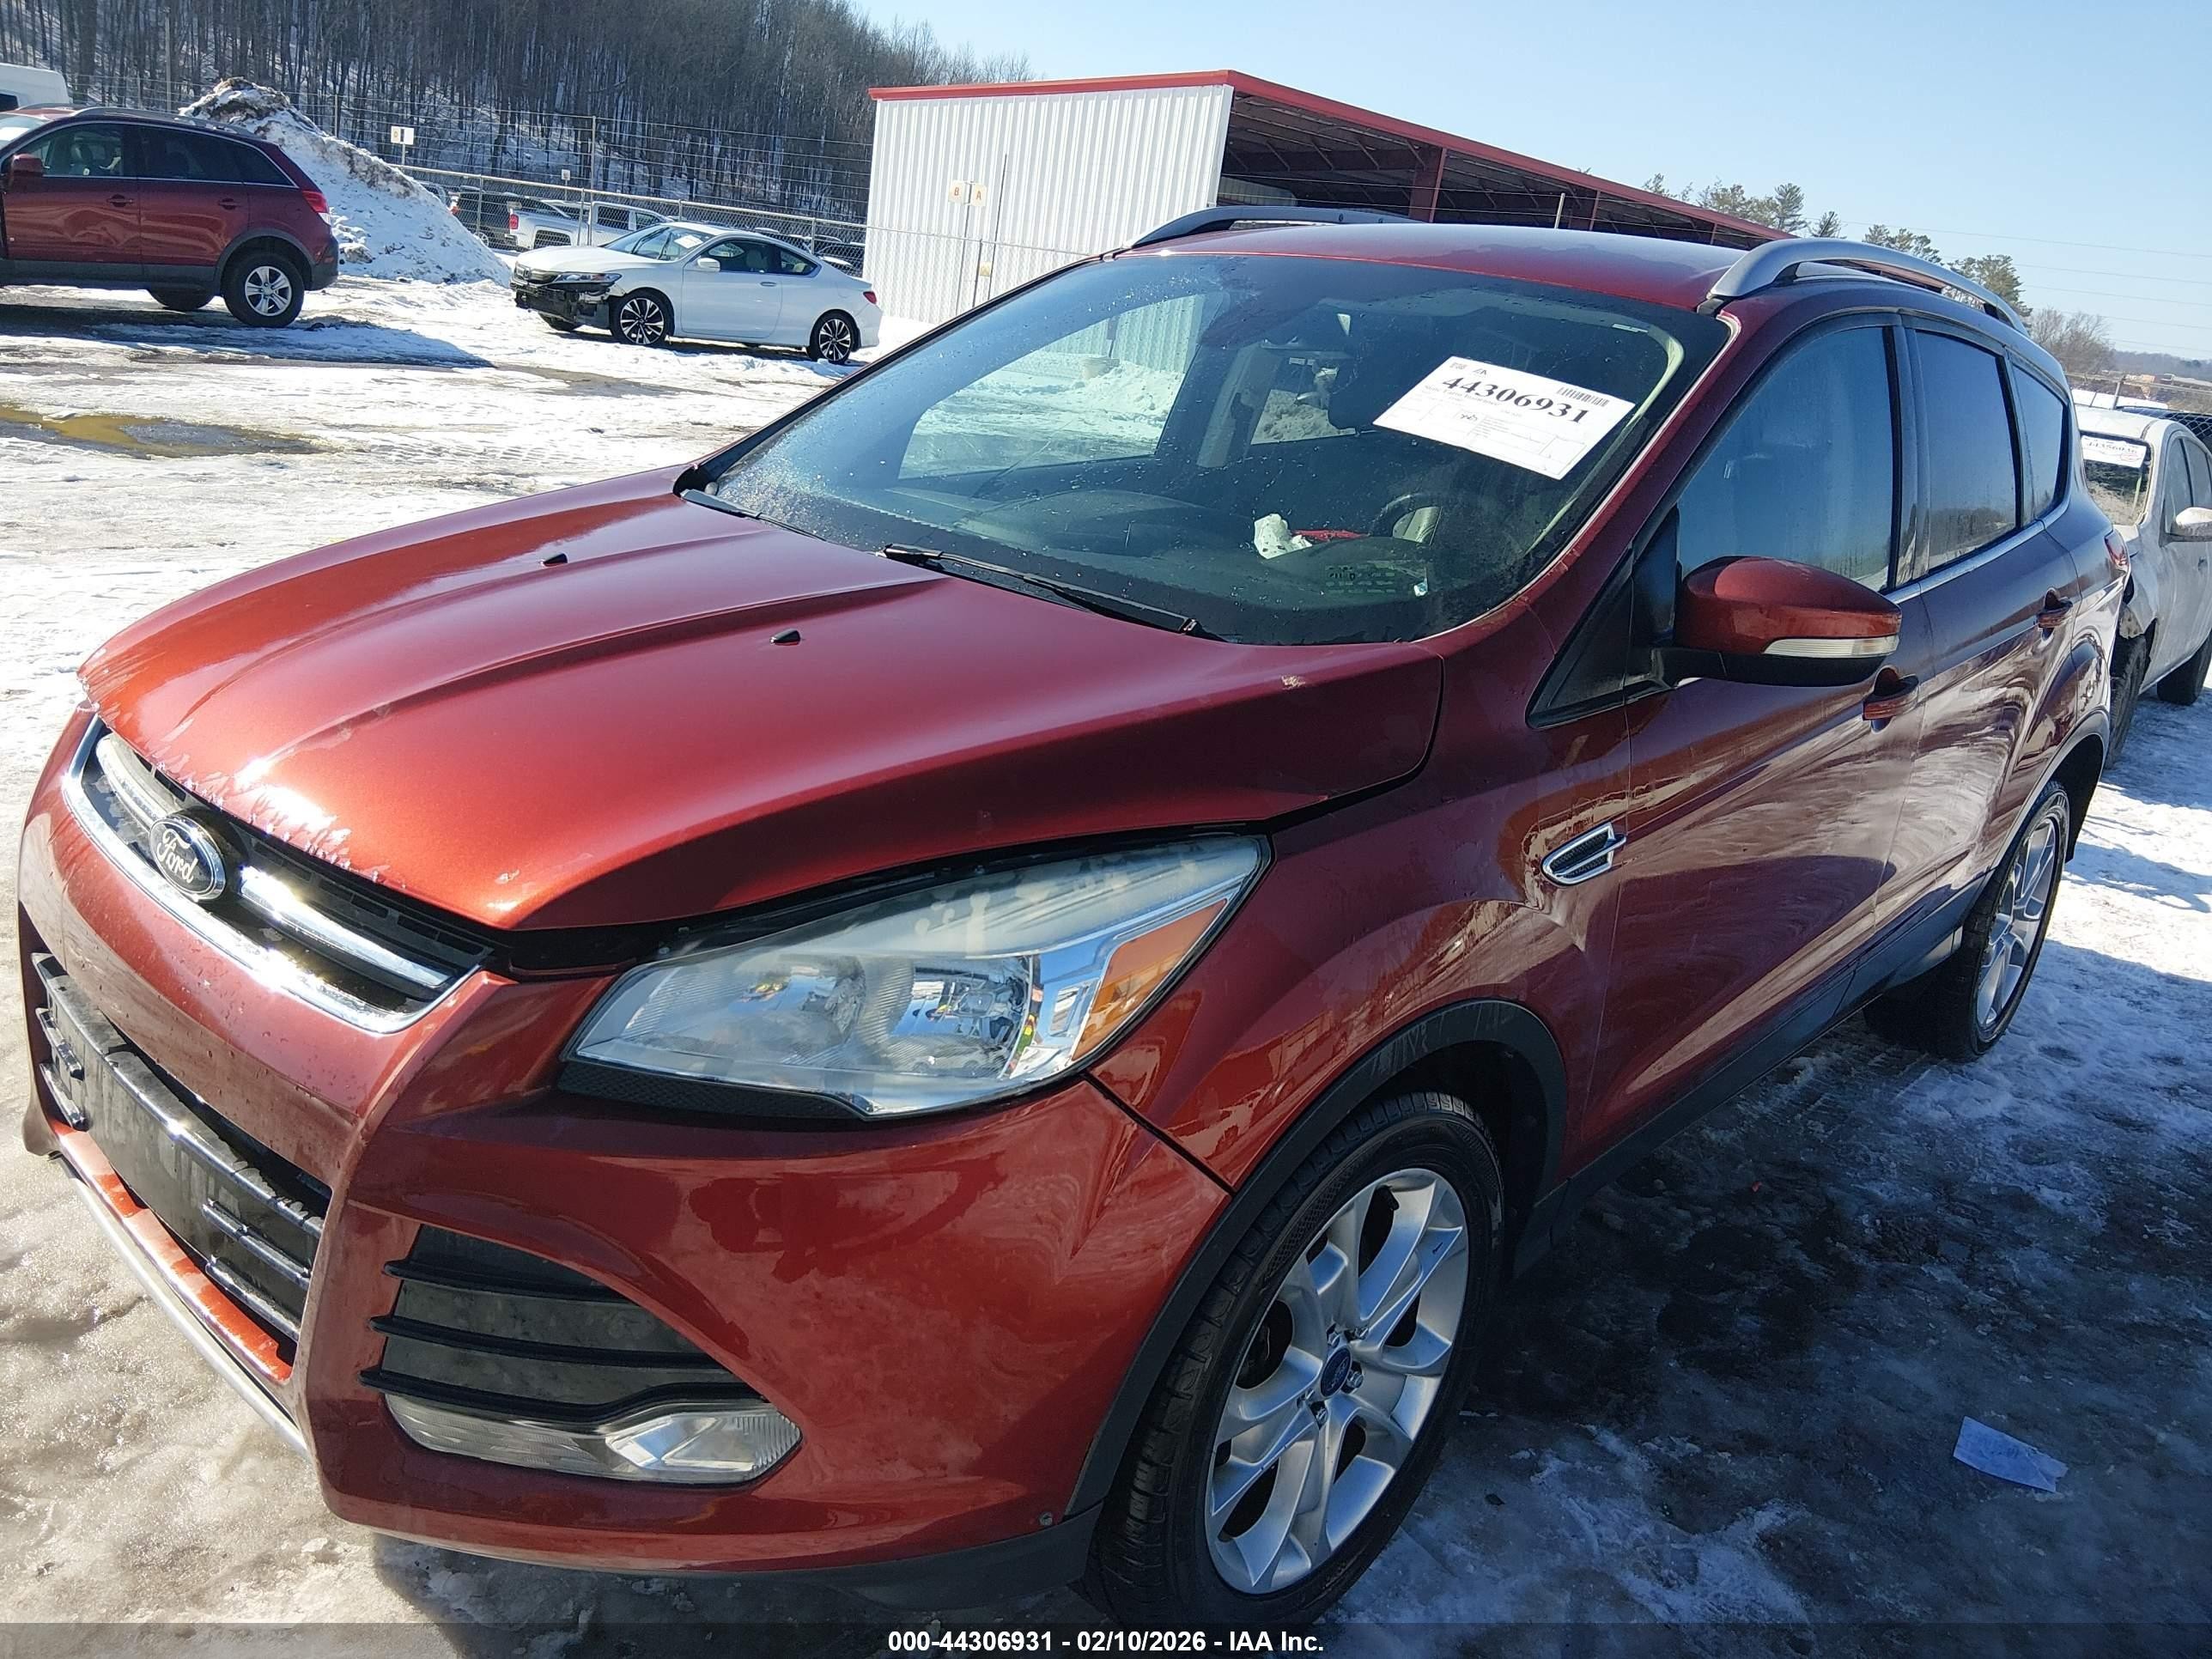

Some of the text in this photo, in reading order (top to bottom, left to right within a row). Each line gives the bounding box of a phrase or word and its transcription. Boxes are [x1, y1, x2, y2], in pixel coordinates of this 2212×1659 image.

[954, 186, 960, 196] B
[975, 190, 981, 200] A
[1442, 377, 1589, 424] 44306931
[156, 828, 198, 884] Ford
